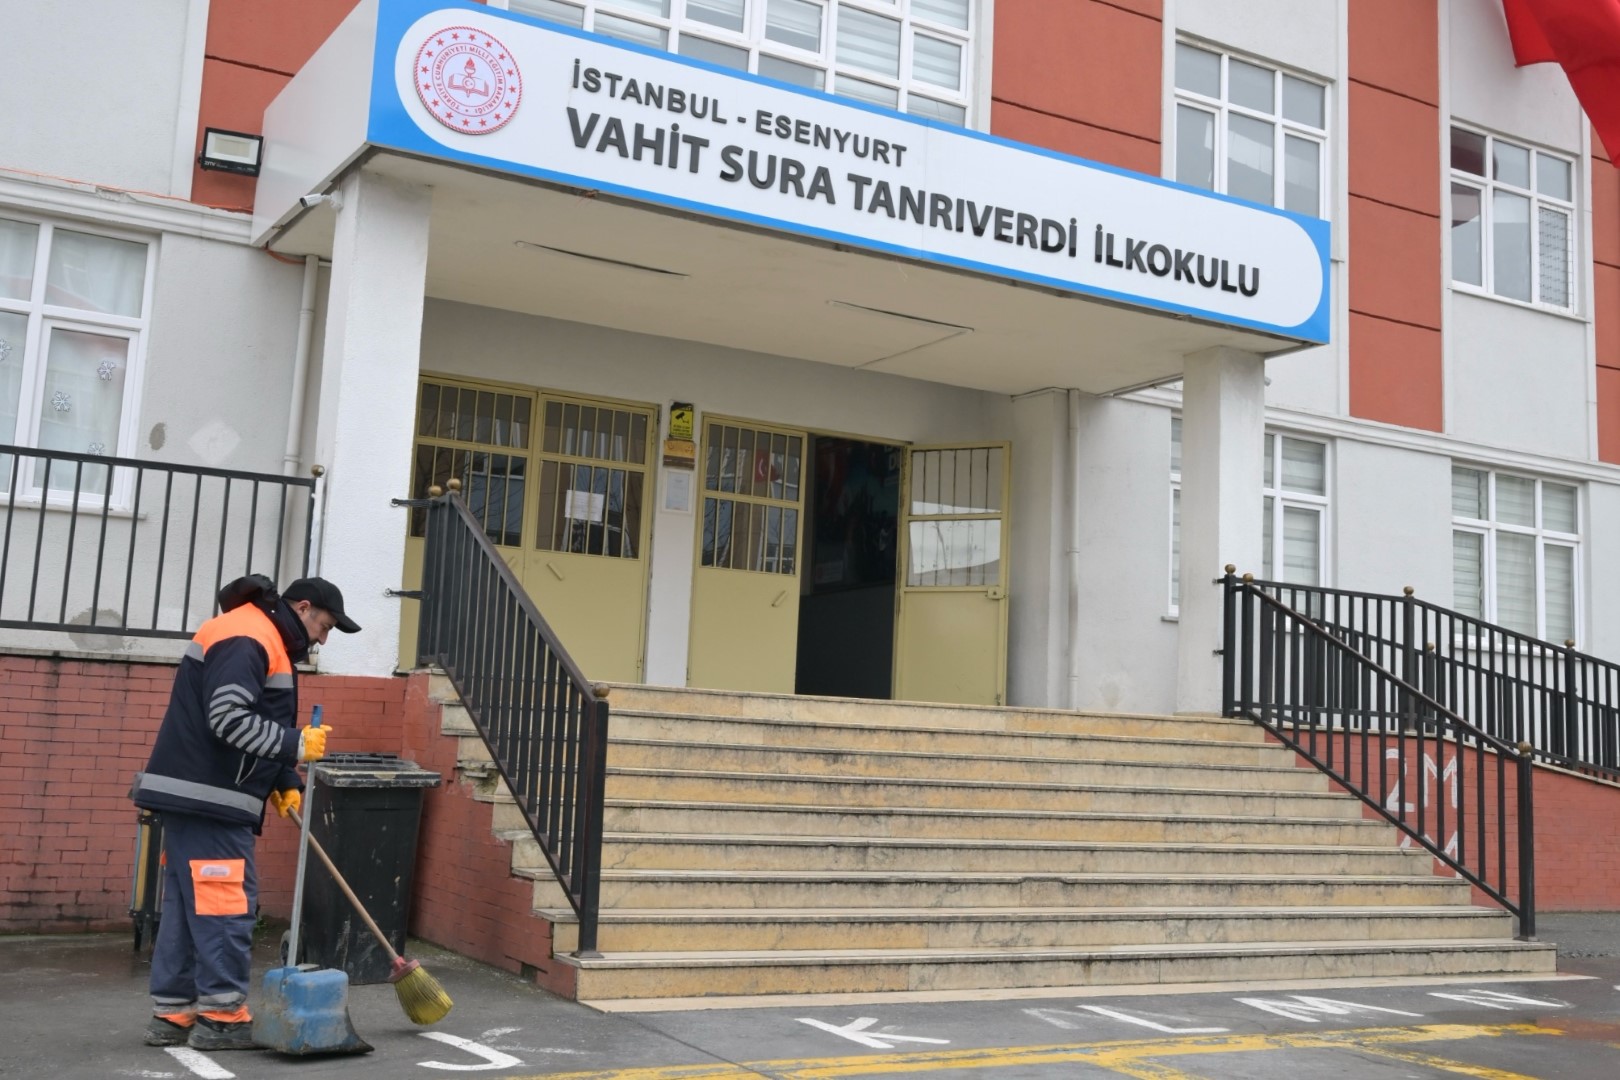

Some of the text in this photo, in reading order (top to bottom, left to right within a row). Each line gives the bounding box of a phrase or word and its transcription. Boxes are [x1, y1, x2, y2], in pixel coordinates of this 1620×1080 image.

[572, 58, 727, 125] İSTANBUL
[755, 109, 907, 167] ESENYURT
[566, 107, 1260, 298] VAHİT SURA TANRIVERDİ İLKOKULU
